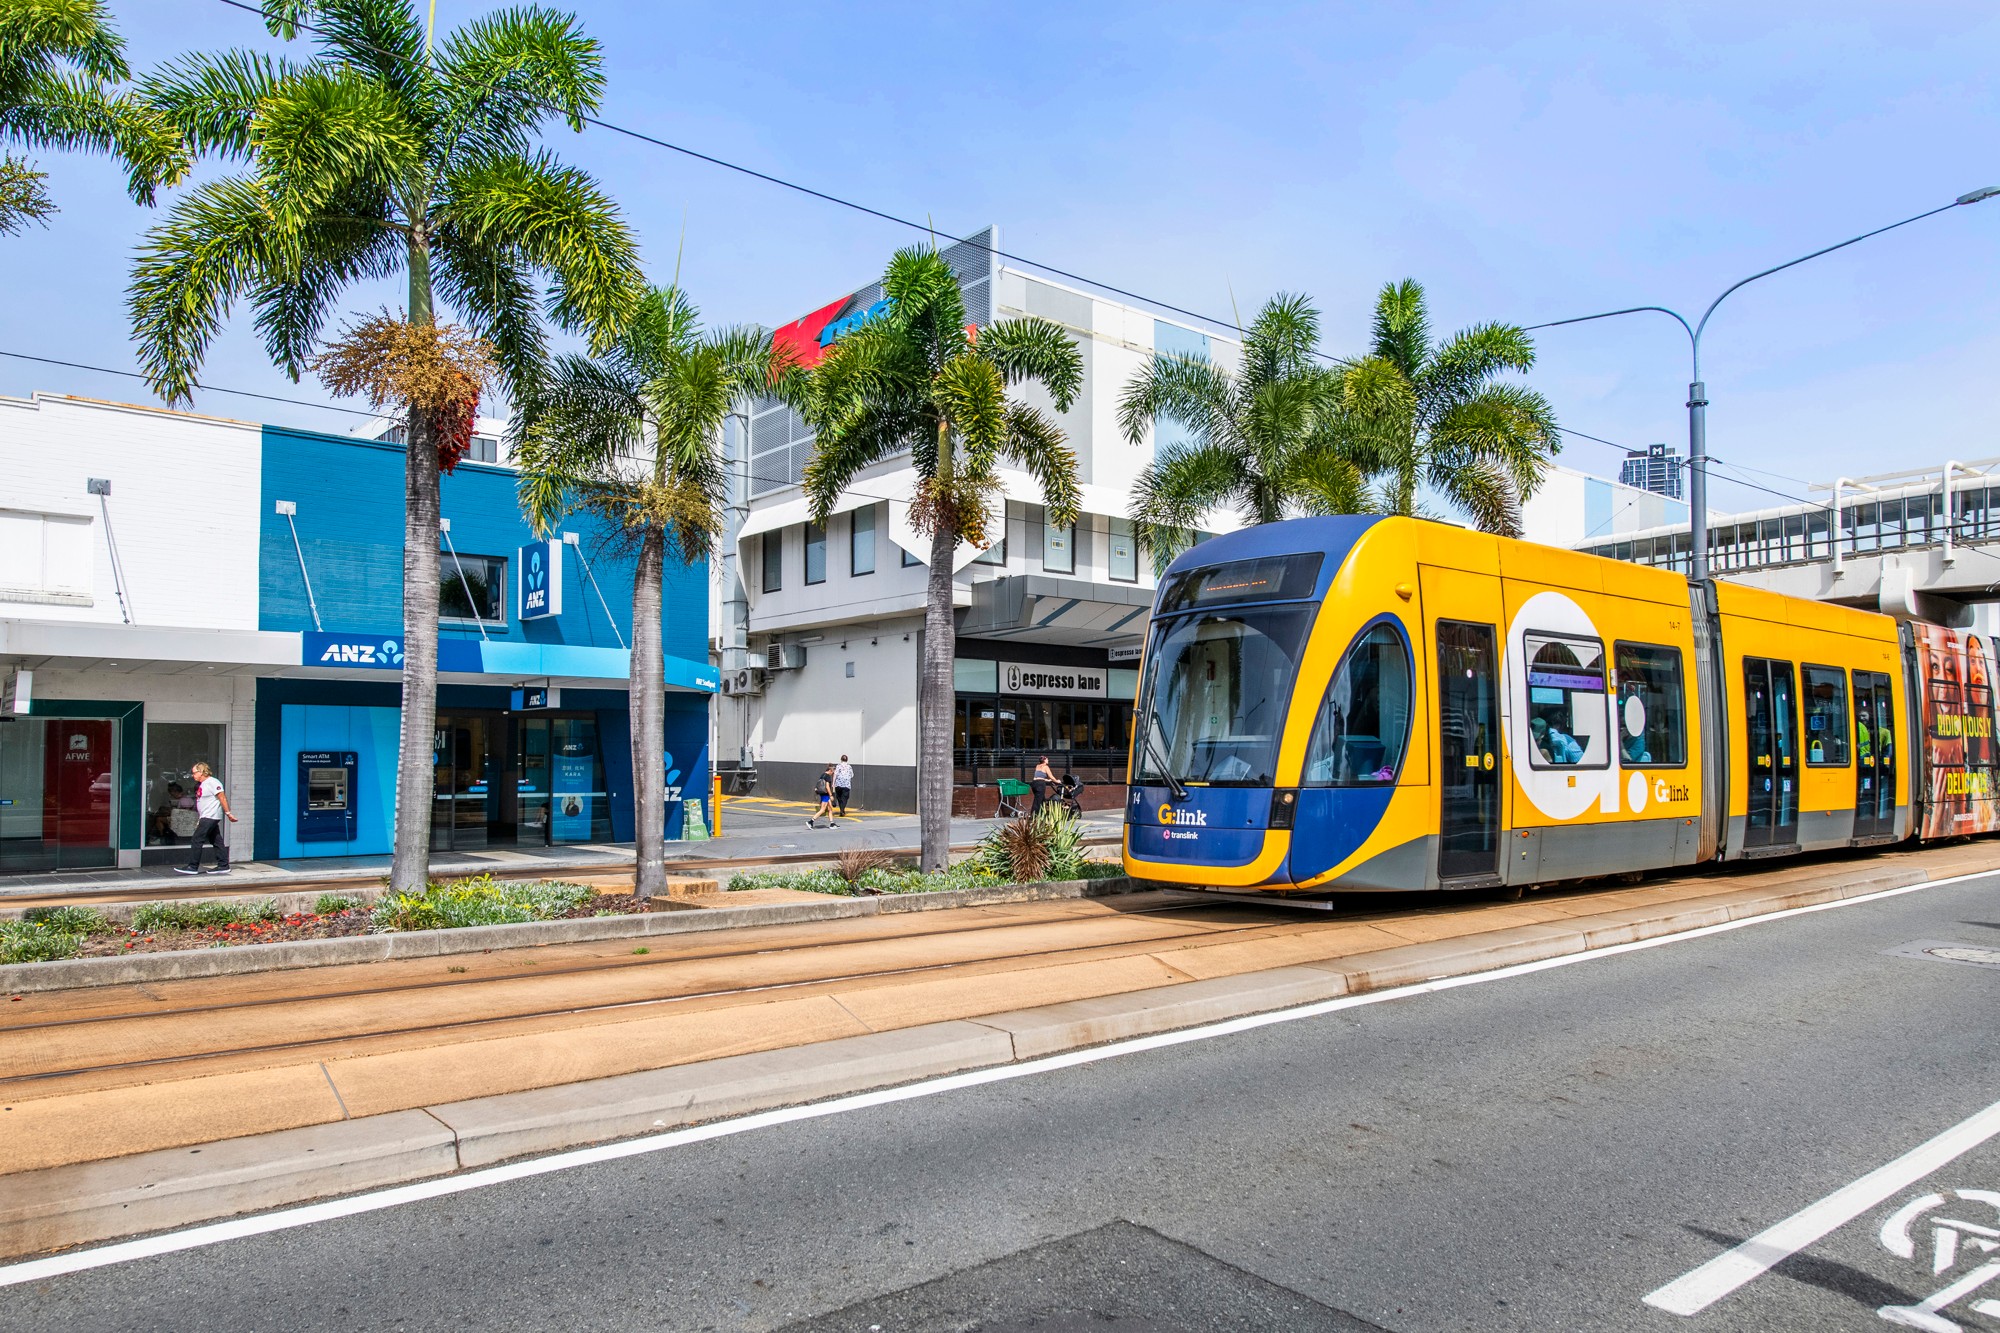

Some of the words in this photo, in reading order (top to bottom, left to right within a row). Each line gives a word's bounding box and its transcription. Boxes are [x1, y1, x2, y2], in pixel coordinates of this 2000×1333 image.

[526, 590, 545, 609] ANZ
[320, 644, 376, 663] ANZ
[1022, 673, 1075, 690] espresso
[1078, 674, 1101, 690] lane
[529, 694, 541, 706] ANZ
[65, 752, 90, 760] AFWE
[1947, 772, 1988, 795] DELICIOUS
[1133, 792, 1141, 804] 14
[1171, 831, 1199, 840] translink
